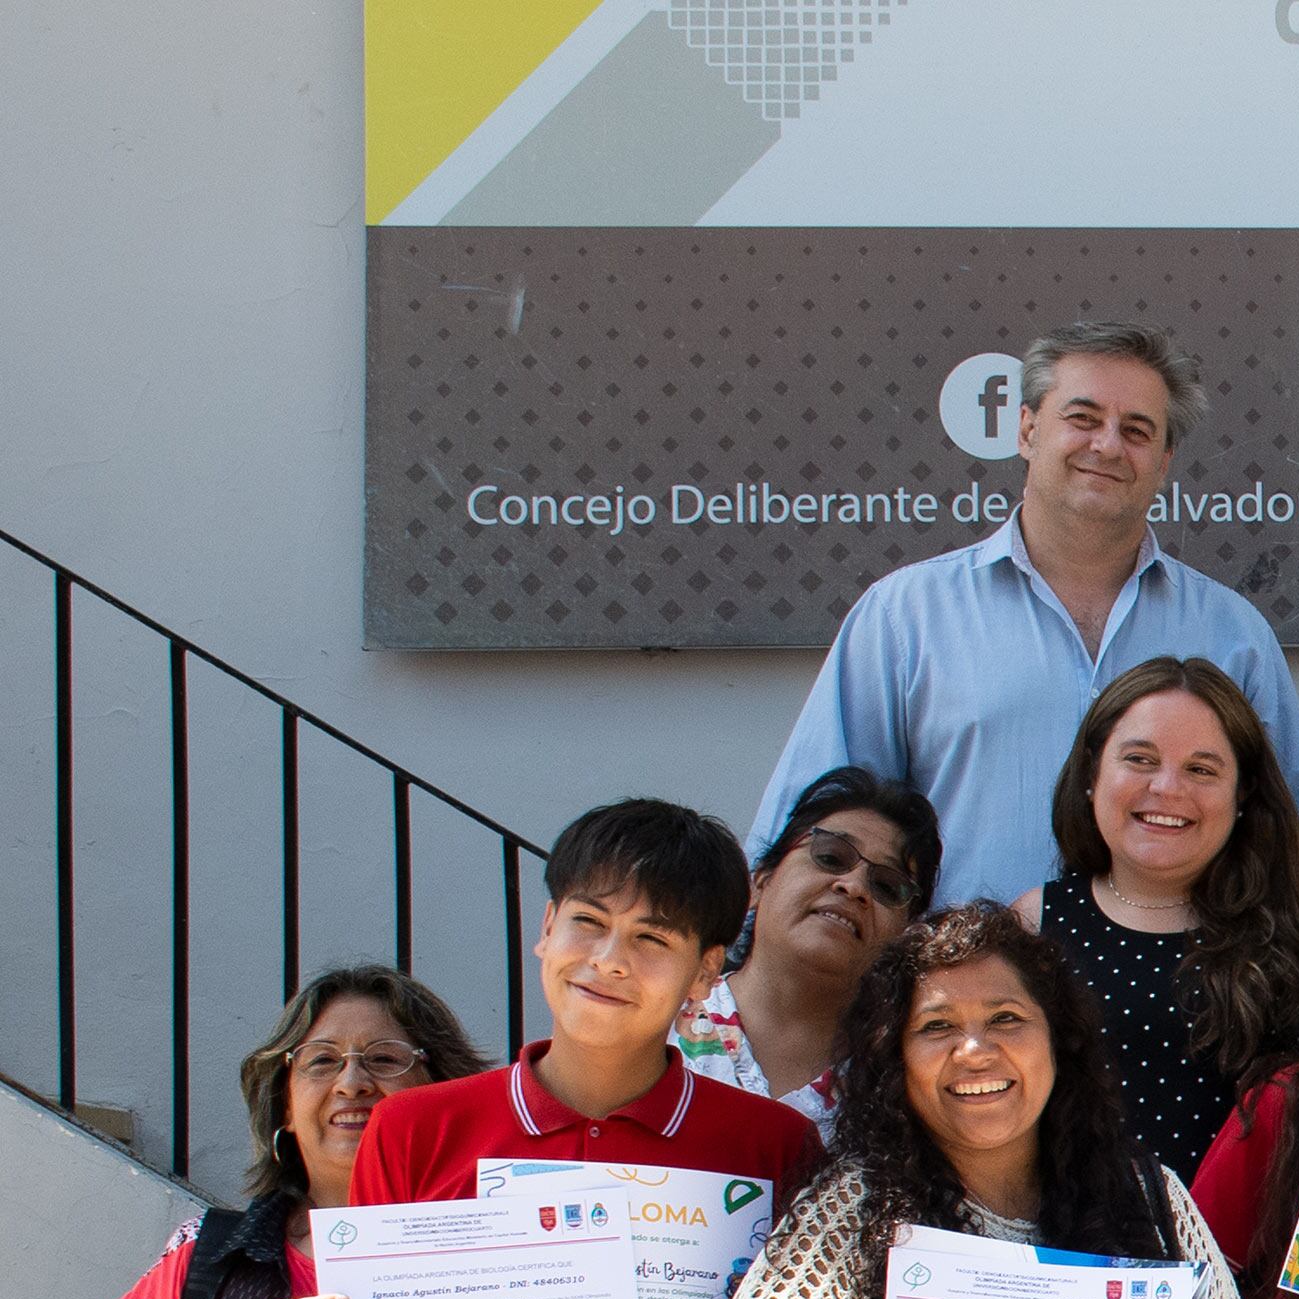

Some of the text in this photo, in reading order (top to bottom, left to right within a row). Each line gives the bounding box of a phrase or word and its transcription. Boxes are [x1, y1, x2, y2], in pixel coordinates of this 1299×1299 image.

[467, 485, 657, 535] Concejo
[671, 482, 939, 524] Deliberante
[951, 481, 1009, 523] de
[628, 1202, 708, 1227] LOMA
[664, 1262, 719, 1282] Bejarano
[372, 1290, 410, 1299] Ignacio
[454, 1283, 500, 1294] Bejarano
[509, 1280, 530, 1289] DNI:
